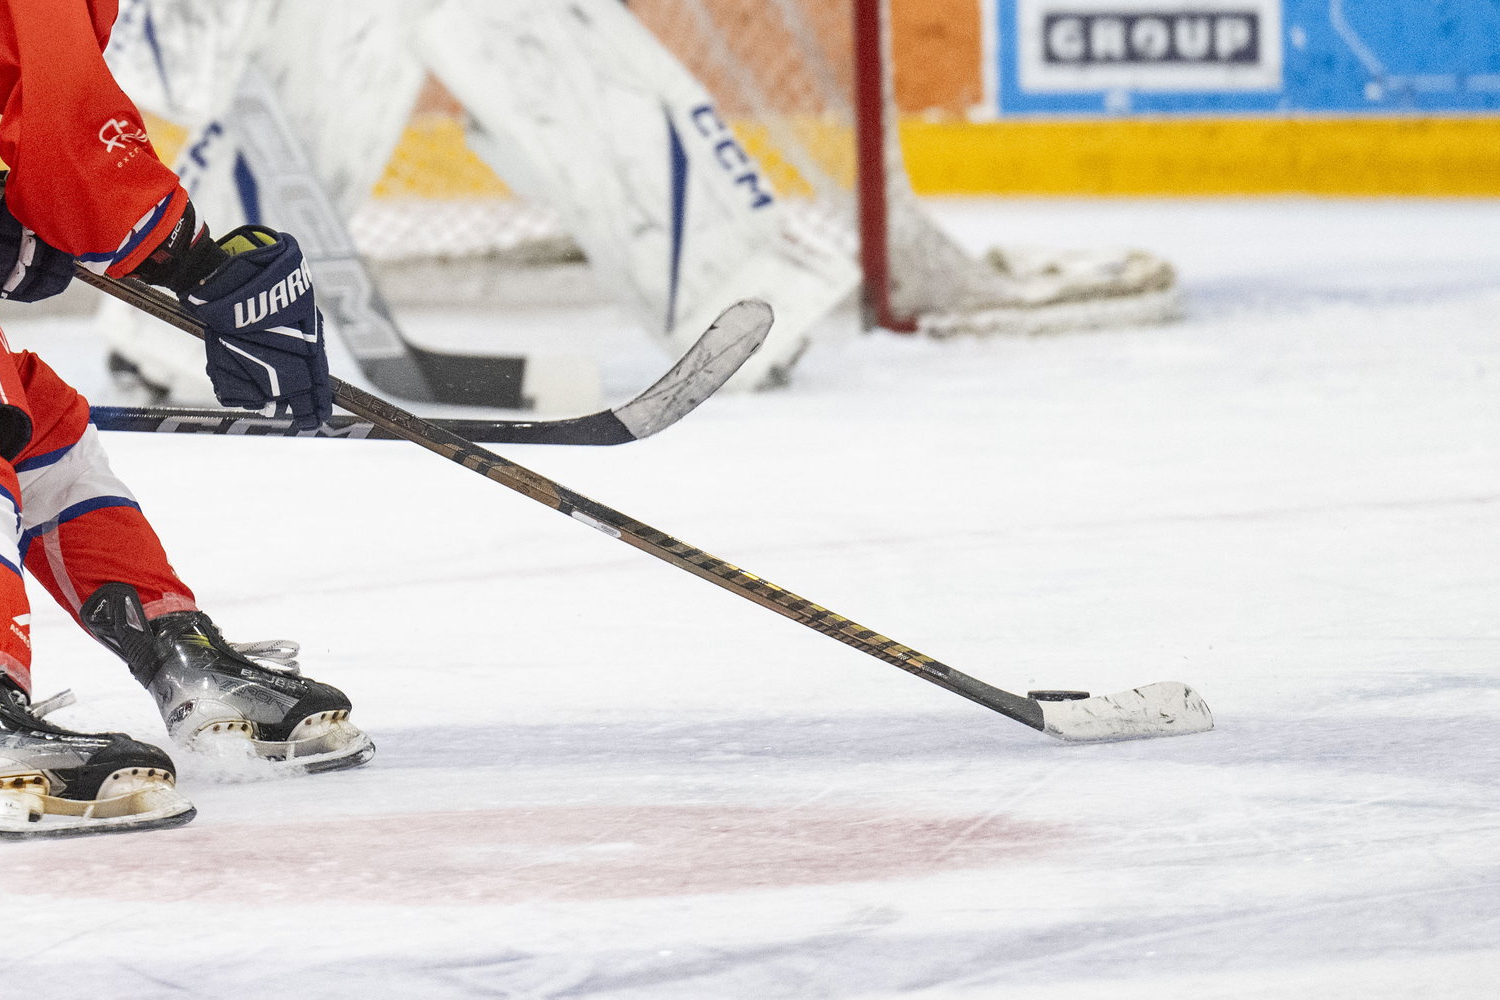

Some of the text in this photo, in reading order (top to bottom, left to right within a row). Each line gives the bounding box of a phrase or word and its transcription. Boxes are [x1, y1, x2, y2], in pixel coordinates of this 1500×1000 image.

[1048, 16, 1254, 60] GROUP
[690, 104, 774, 209] CCM
[233, 256, 313, 330] WARR
